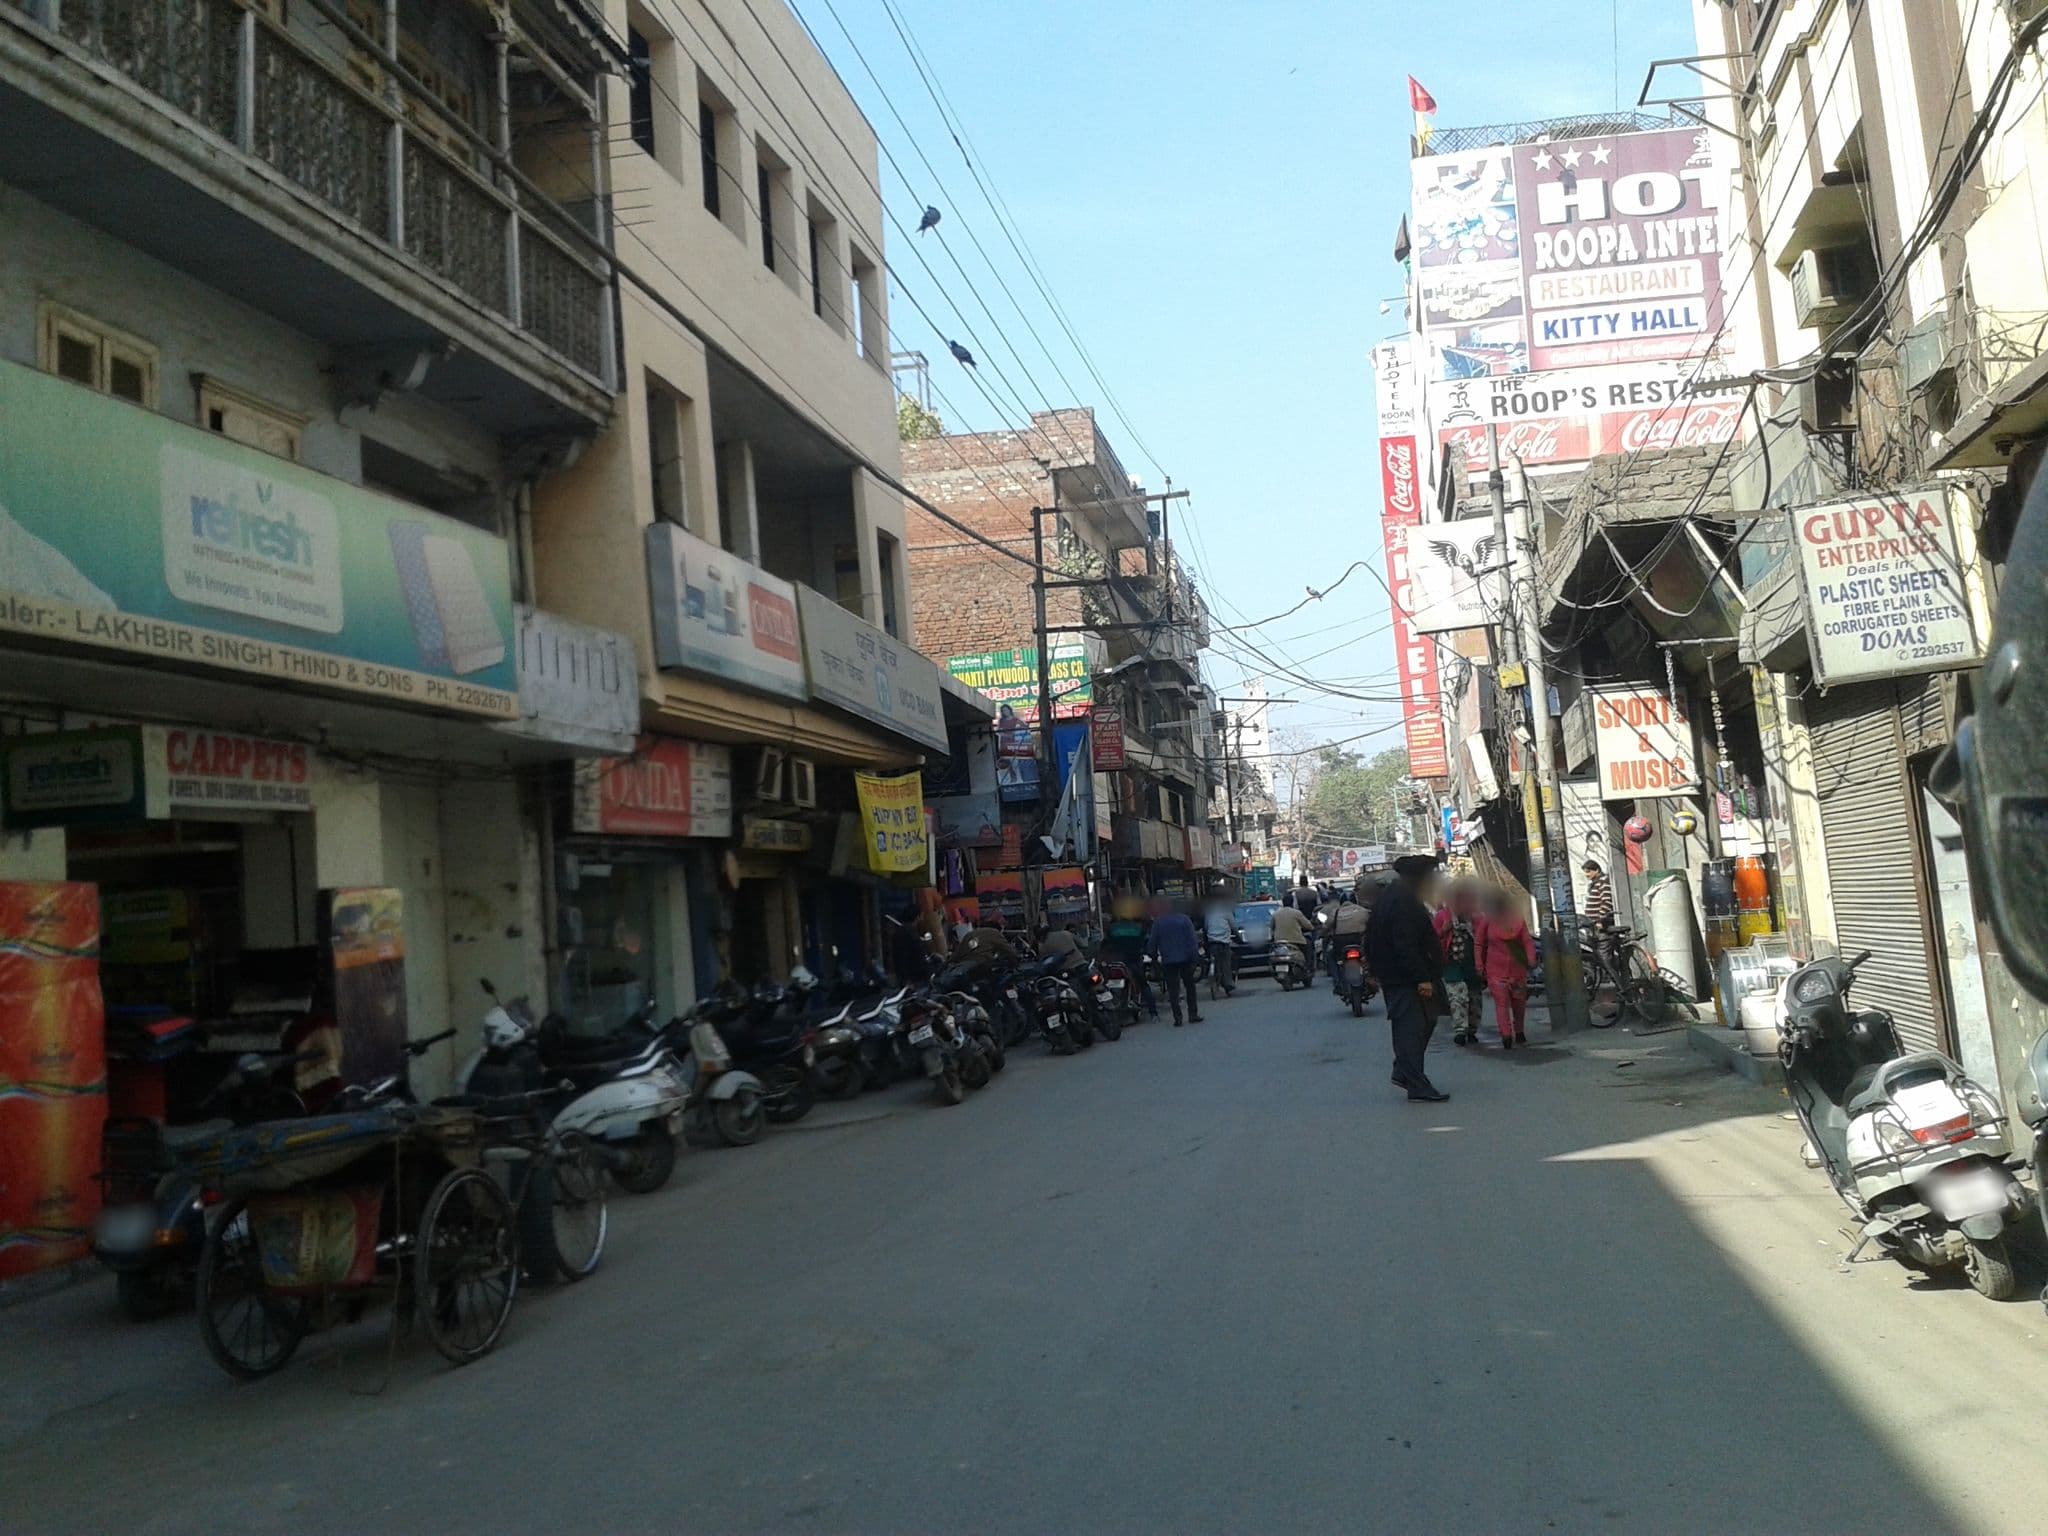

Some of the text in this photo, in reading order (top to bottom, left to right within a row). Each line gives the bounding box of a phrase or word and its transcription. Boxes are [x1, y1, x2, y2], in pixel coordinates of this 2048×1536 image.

[1533, 222, 1639, 270] ROOPA
[1541, 265, 1693, 301] RESTAURANT
[1543, 306, 1699, 341] KITTY HALL
[1489, 379, 1523, 393] THE
[1491, 386, 1598, 417] ROOP'S
[1803, 499, 1942, 545] GUPTA
[1817, 533, 1939, 569] ENTERPRISES
[1846, 561, 1890, 577] Deals
[1819, 568, 1950, 605] PLASTIC SHEETS
[1824, 605, 1960, 636] CORRUGATED SHEETS
[1843, 592, 1933, 618] FIBRE PLAIN &
[75, 609, 194, 654] LAKHBIR
[202, 634, 273, 673] SINGH
[277, 651, 340, 679] THIND
[347, 666, 358, 683] &
[365, 667, 413, 693] SONS
[1860, 625, 1928, 652] DOMS
[1912, 641, 1965, 659] 2292537
[987, 666, 1031, 686] PLYWOOD
[1071, 660, 1087, 677] CO.
[166, 730, 308, 785] CARPETS
[1638, 732, 1653, 752] &
[608, 758, 687, 812] ONIDA
[1610, 757, 1688, 791] MUSIC
